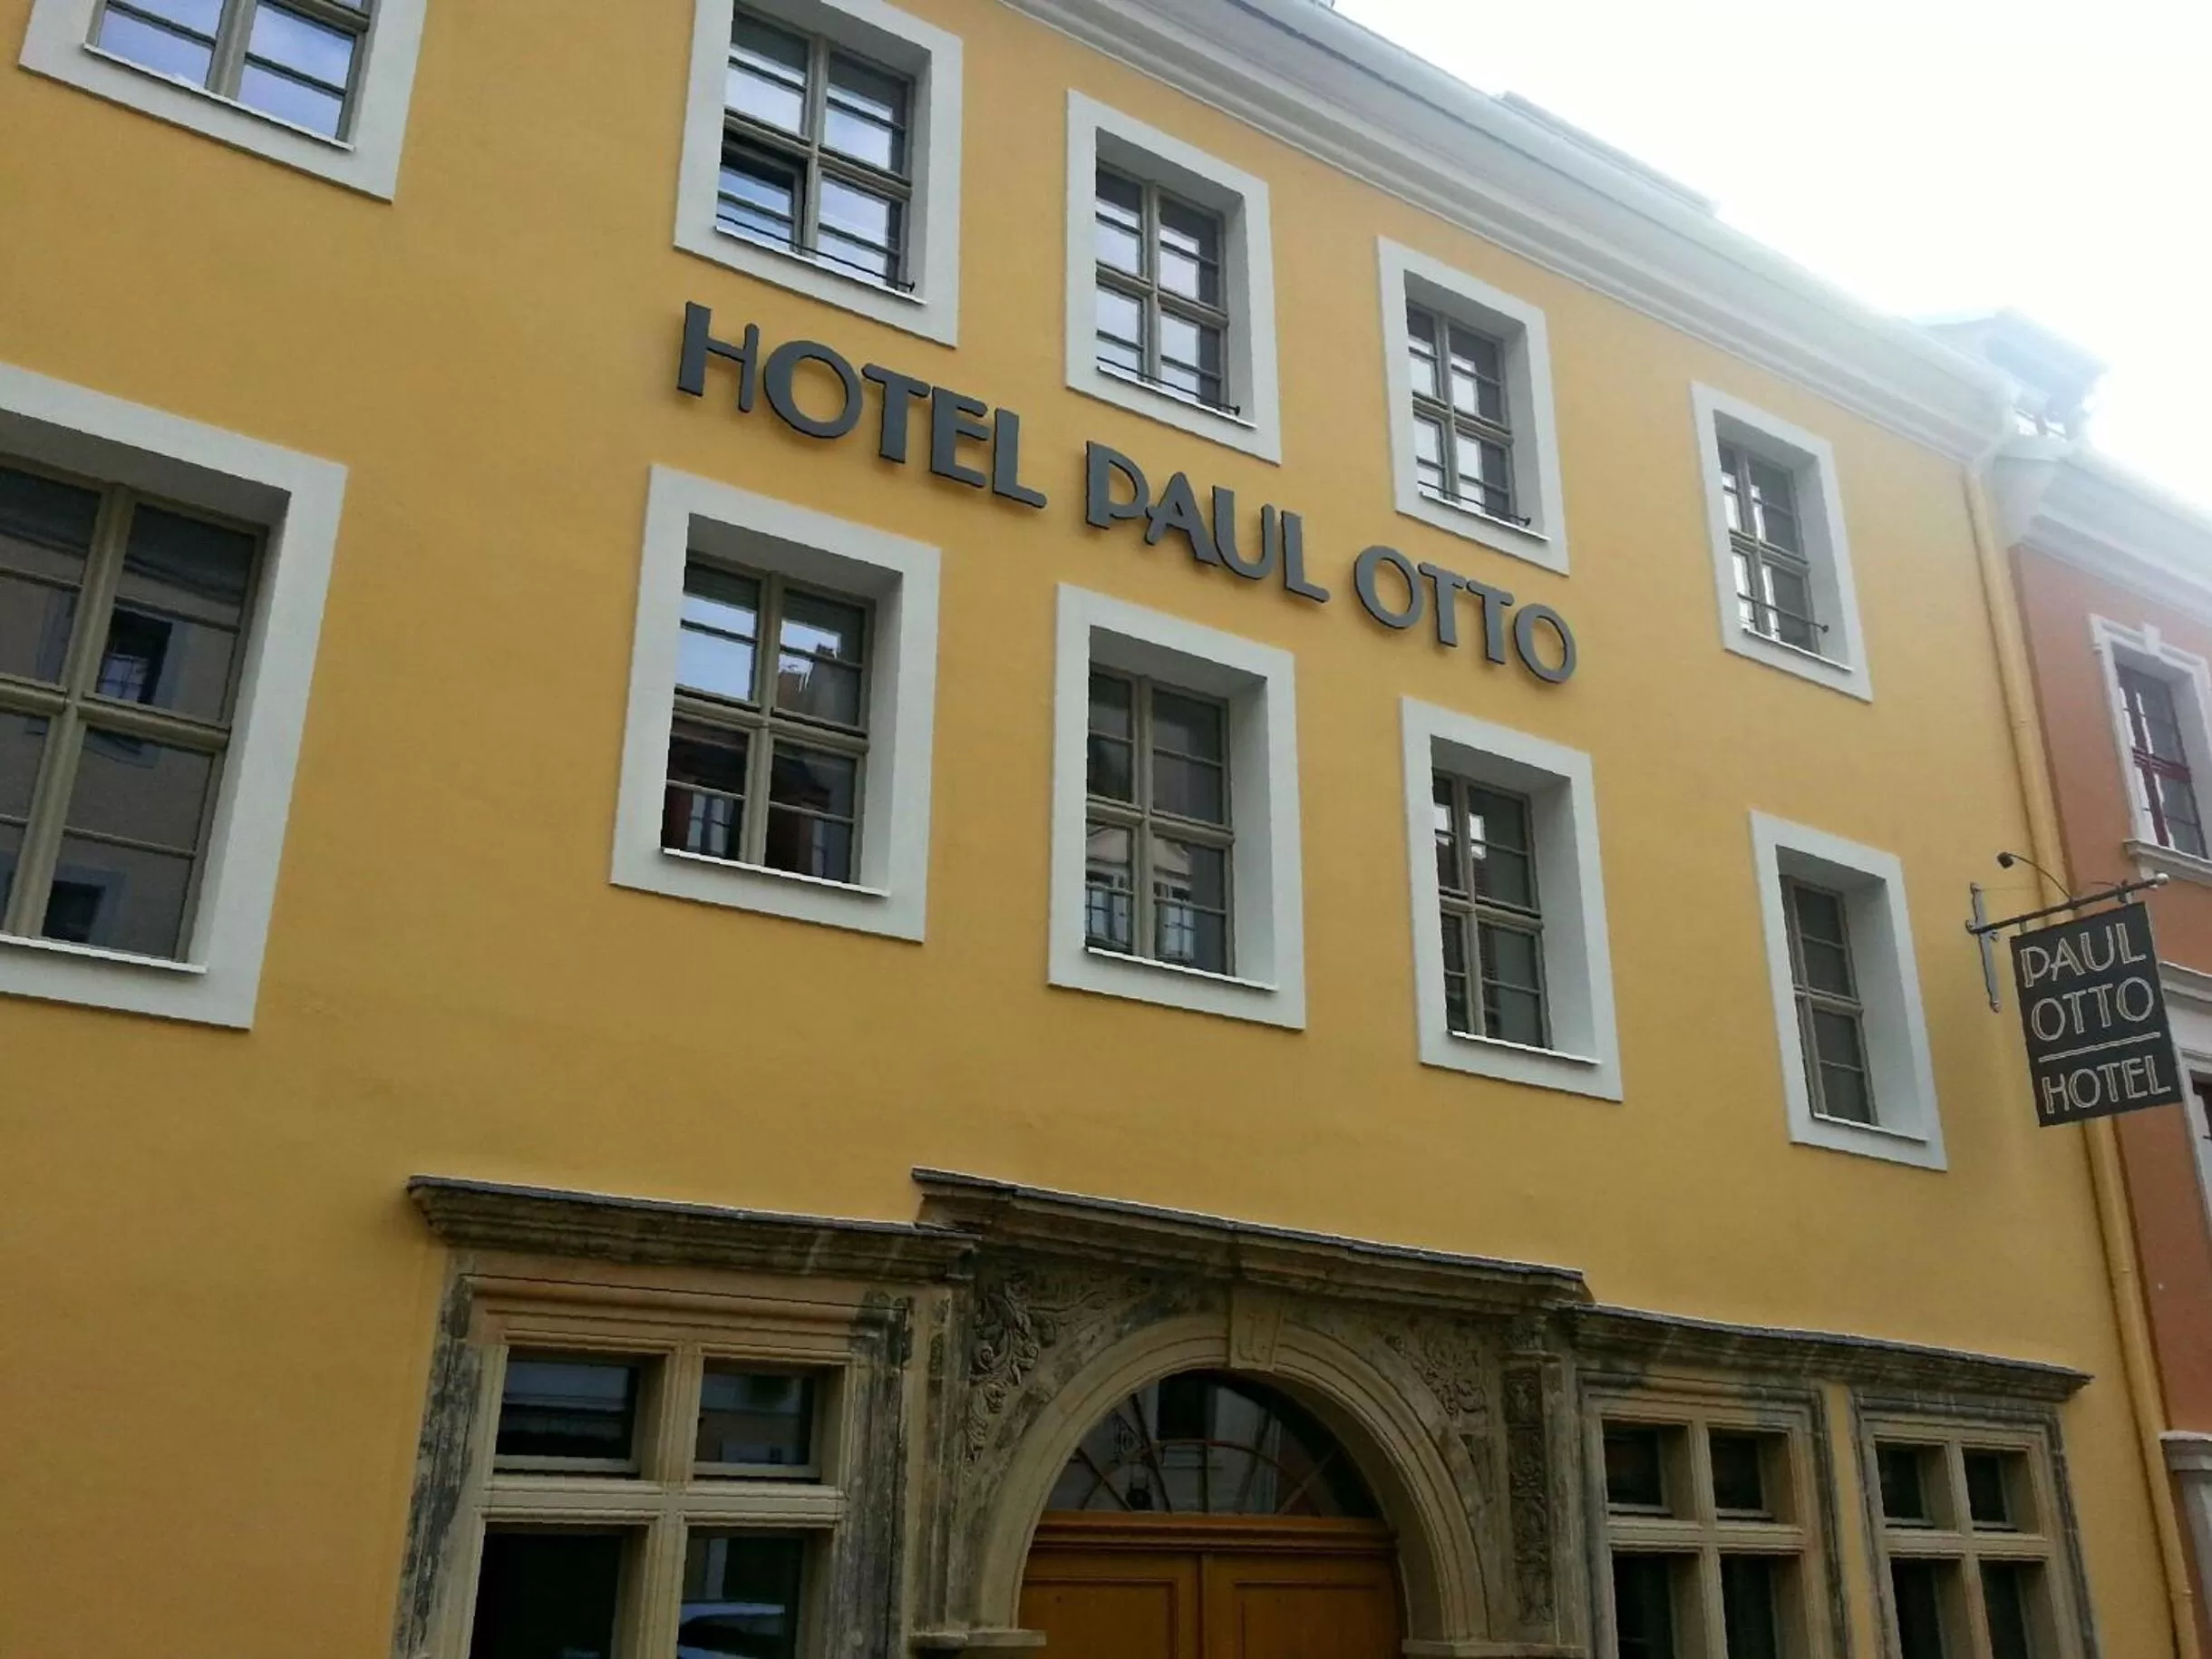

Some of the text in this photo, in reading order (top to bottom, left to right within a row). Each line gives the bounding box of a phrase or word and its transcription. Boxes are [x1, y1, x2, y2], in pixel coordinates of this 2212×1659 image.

[677, 301, 1577, 684] HOTEL PAUL OTTO
[2020, 923, 2147, 988] PAUL
[2031, 976, 2154, 1041] OTTO
[2042, 1055, 2171, 1114] HOTEL
